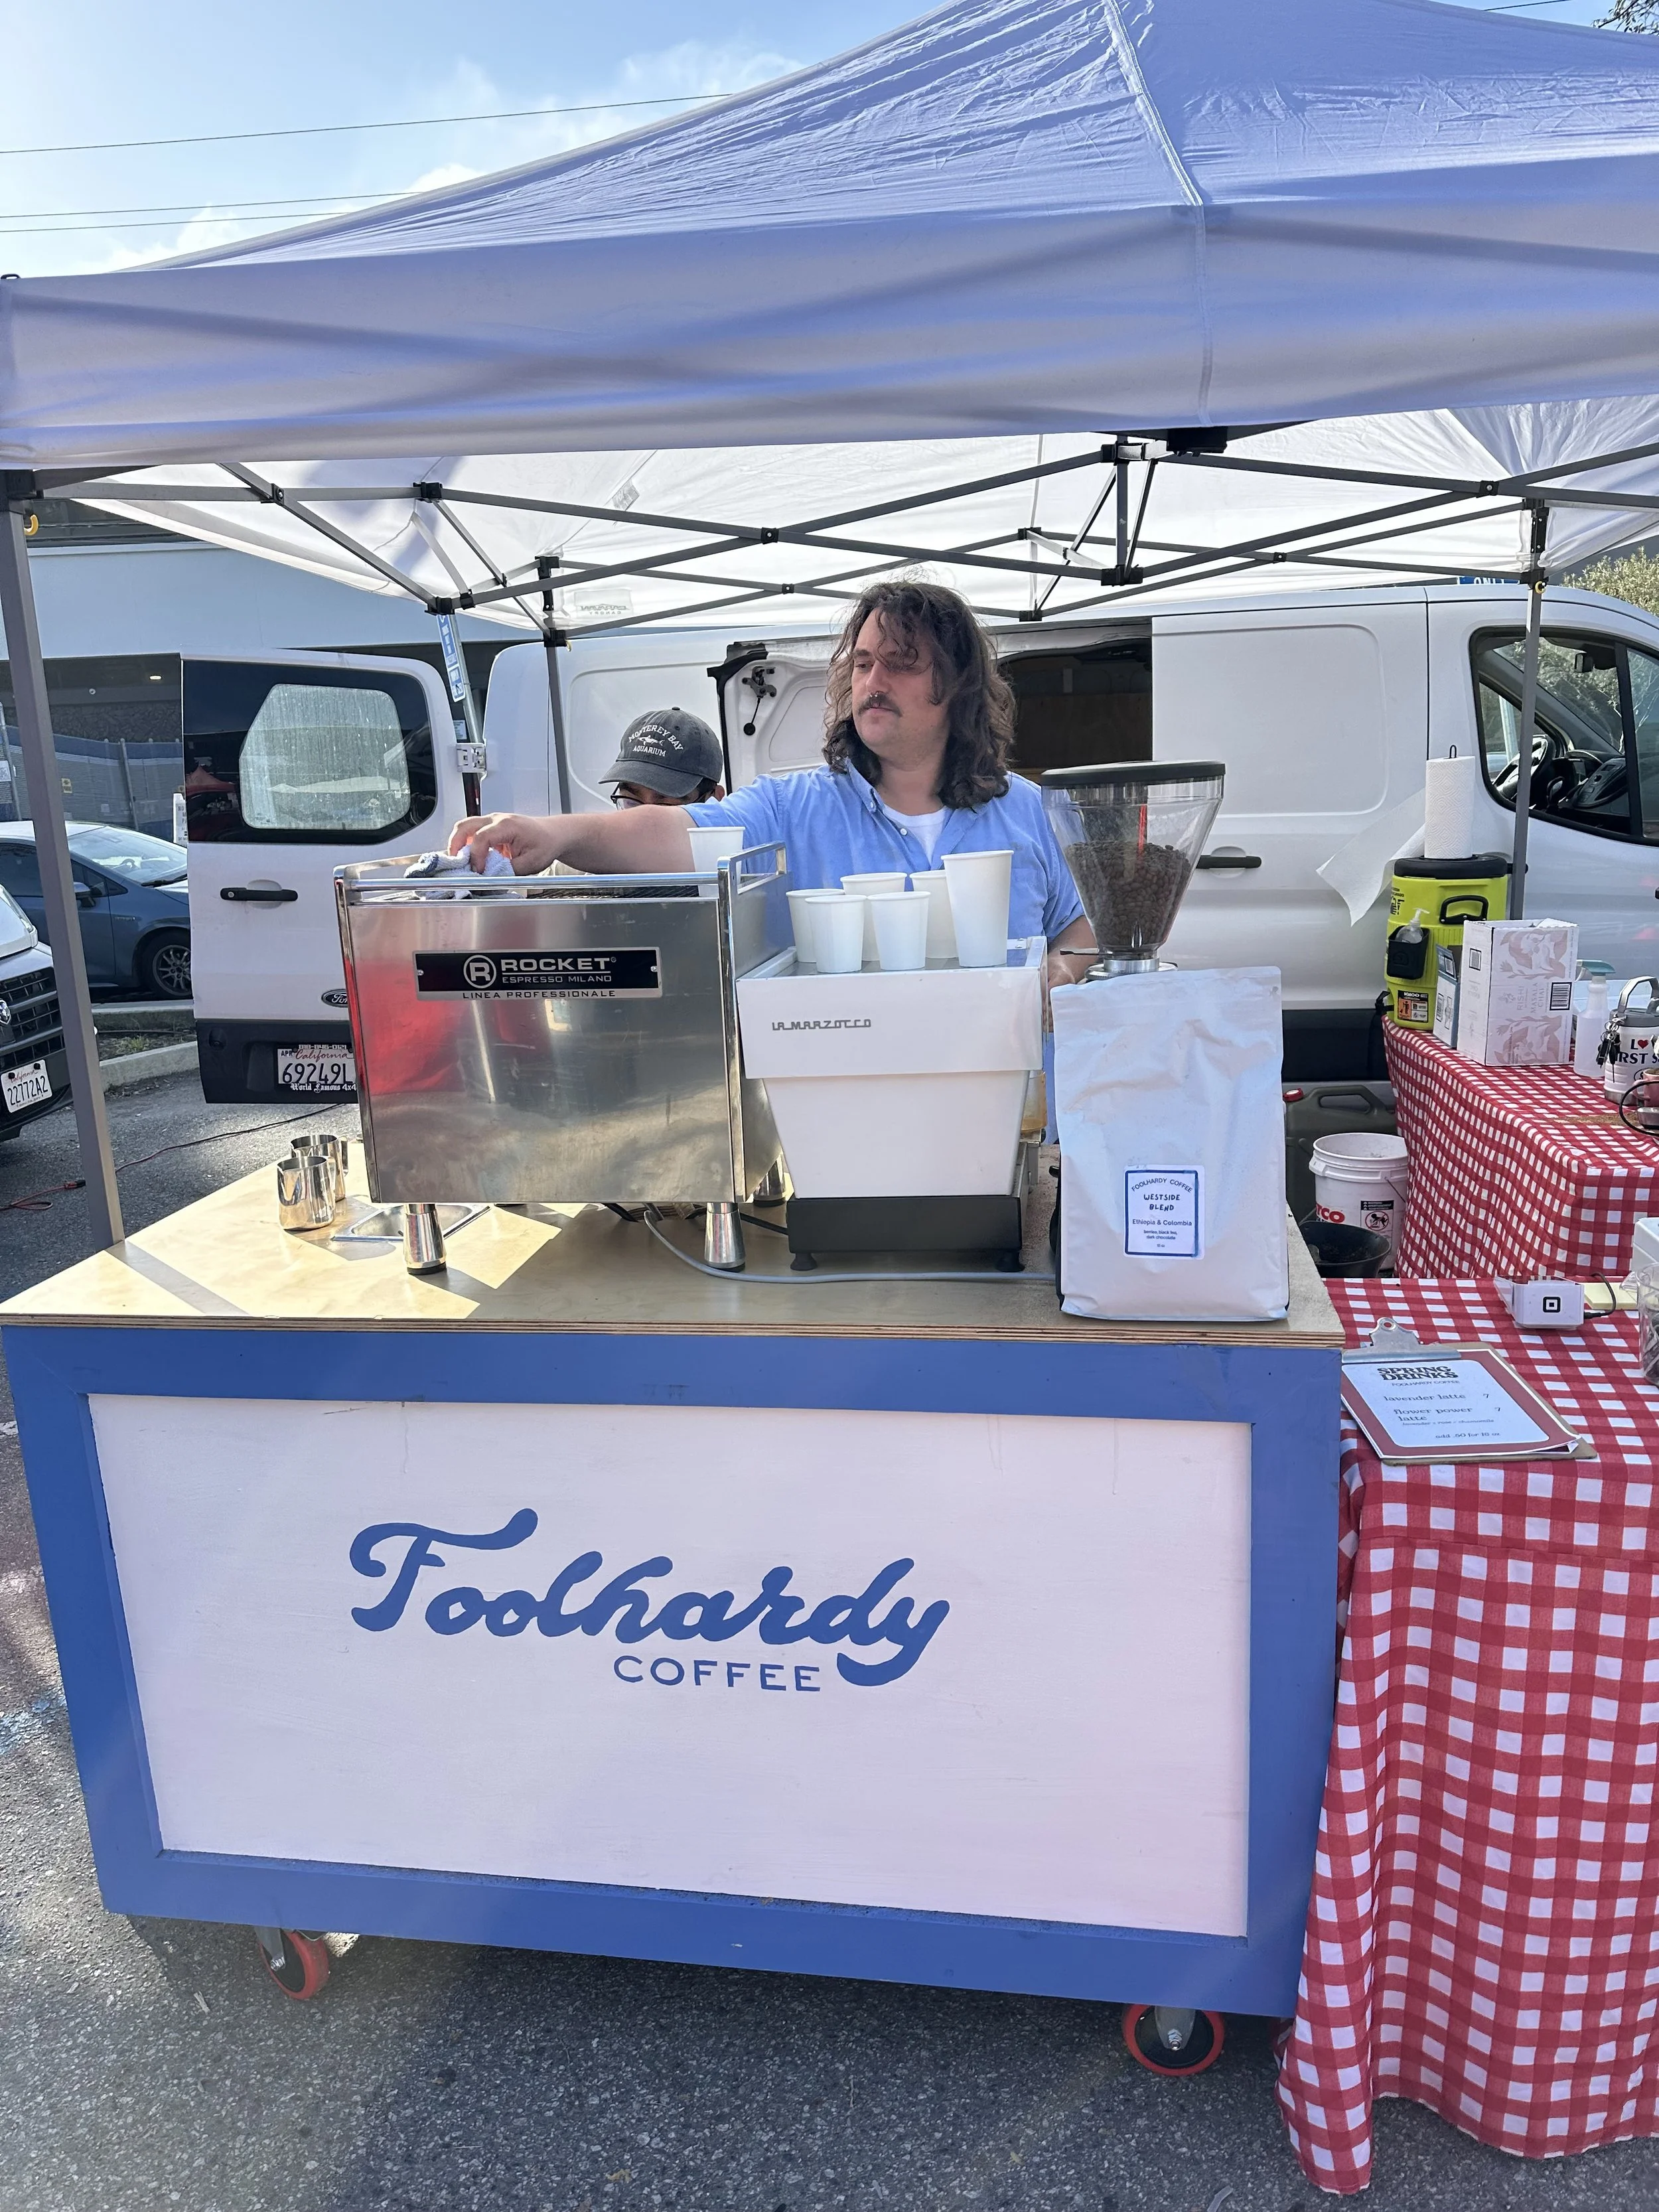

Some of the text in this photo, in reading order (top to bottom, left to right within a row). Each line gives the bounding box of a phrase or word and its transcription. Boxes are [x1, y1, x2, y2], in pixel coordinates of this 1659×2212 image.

[628, 725, 684, 750] MONTEREY BAY
[632, 745, 666, 757] AQUARIUM
[501, 958, 610, 971] ROCKET
[332, 994, 347, 1003] Fo
[295, 1049, 354, 1063] California
[7, 1076, 48, 1106] 22772A2
[315, 1083, 340, 1094] Famous
[1131, 1178, 1192, 1193] FOOLHARDY COFFEE
[1377, 1366, 1451, 1374] SPRING
[1380, 1372, 1459, 1380] DRINKS
[350, 1507, 950, 1687] Foolhardy
[613, 1655, 821, 1692] COFFEE
